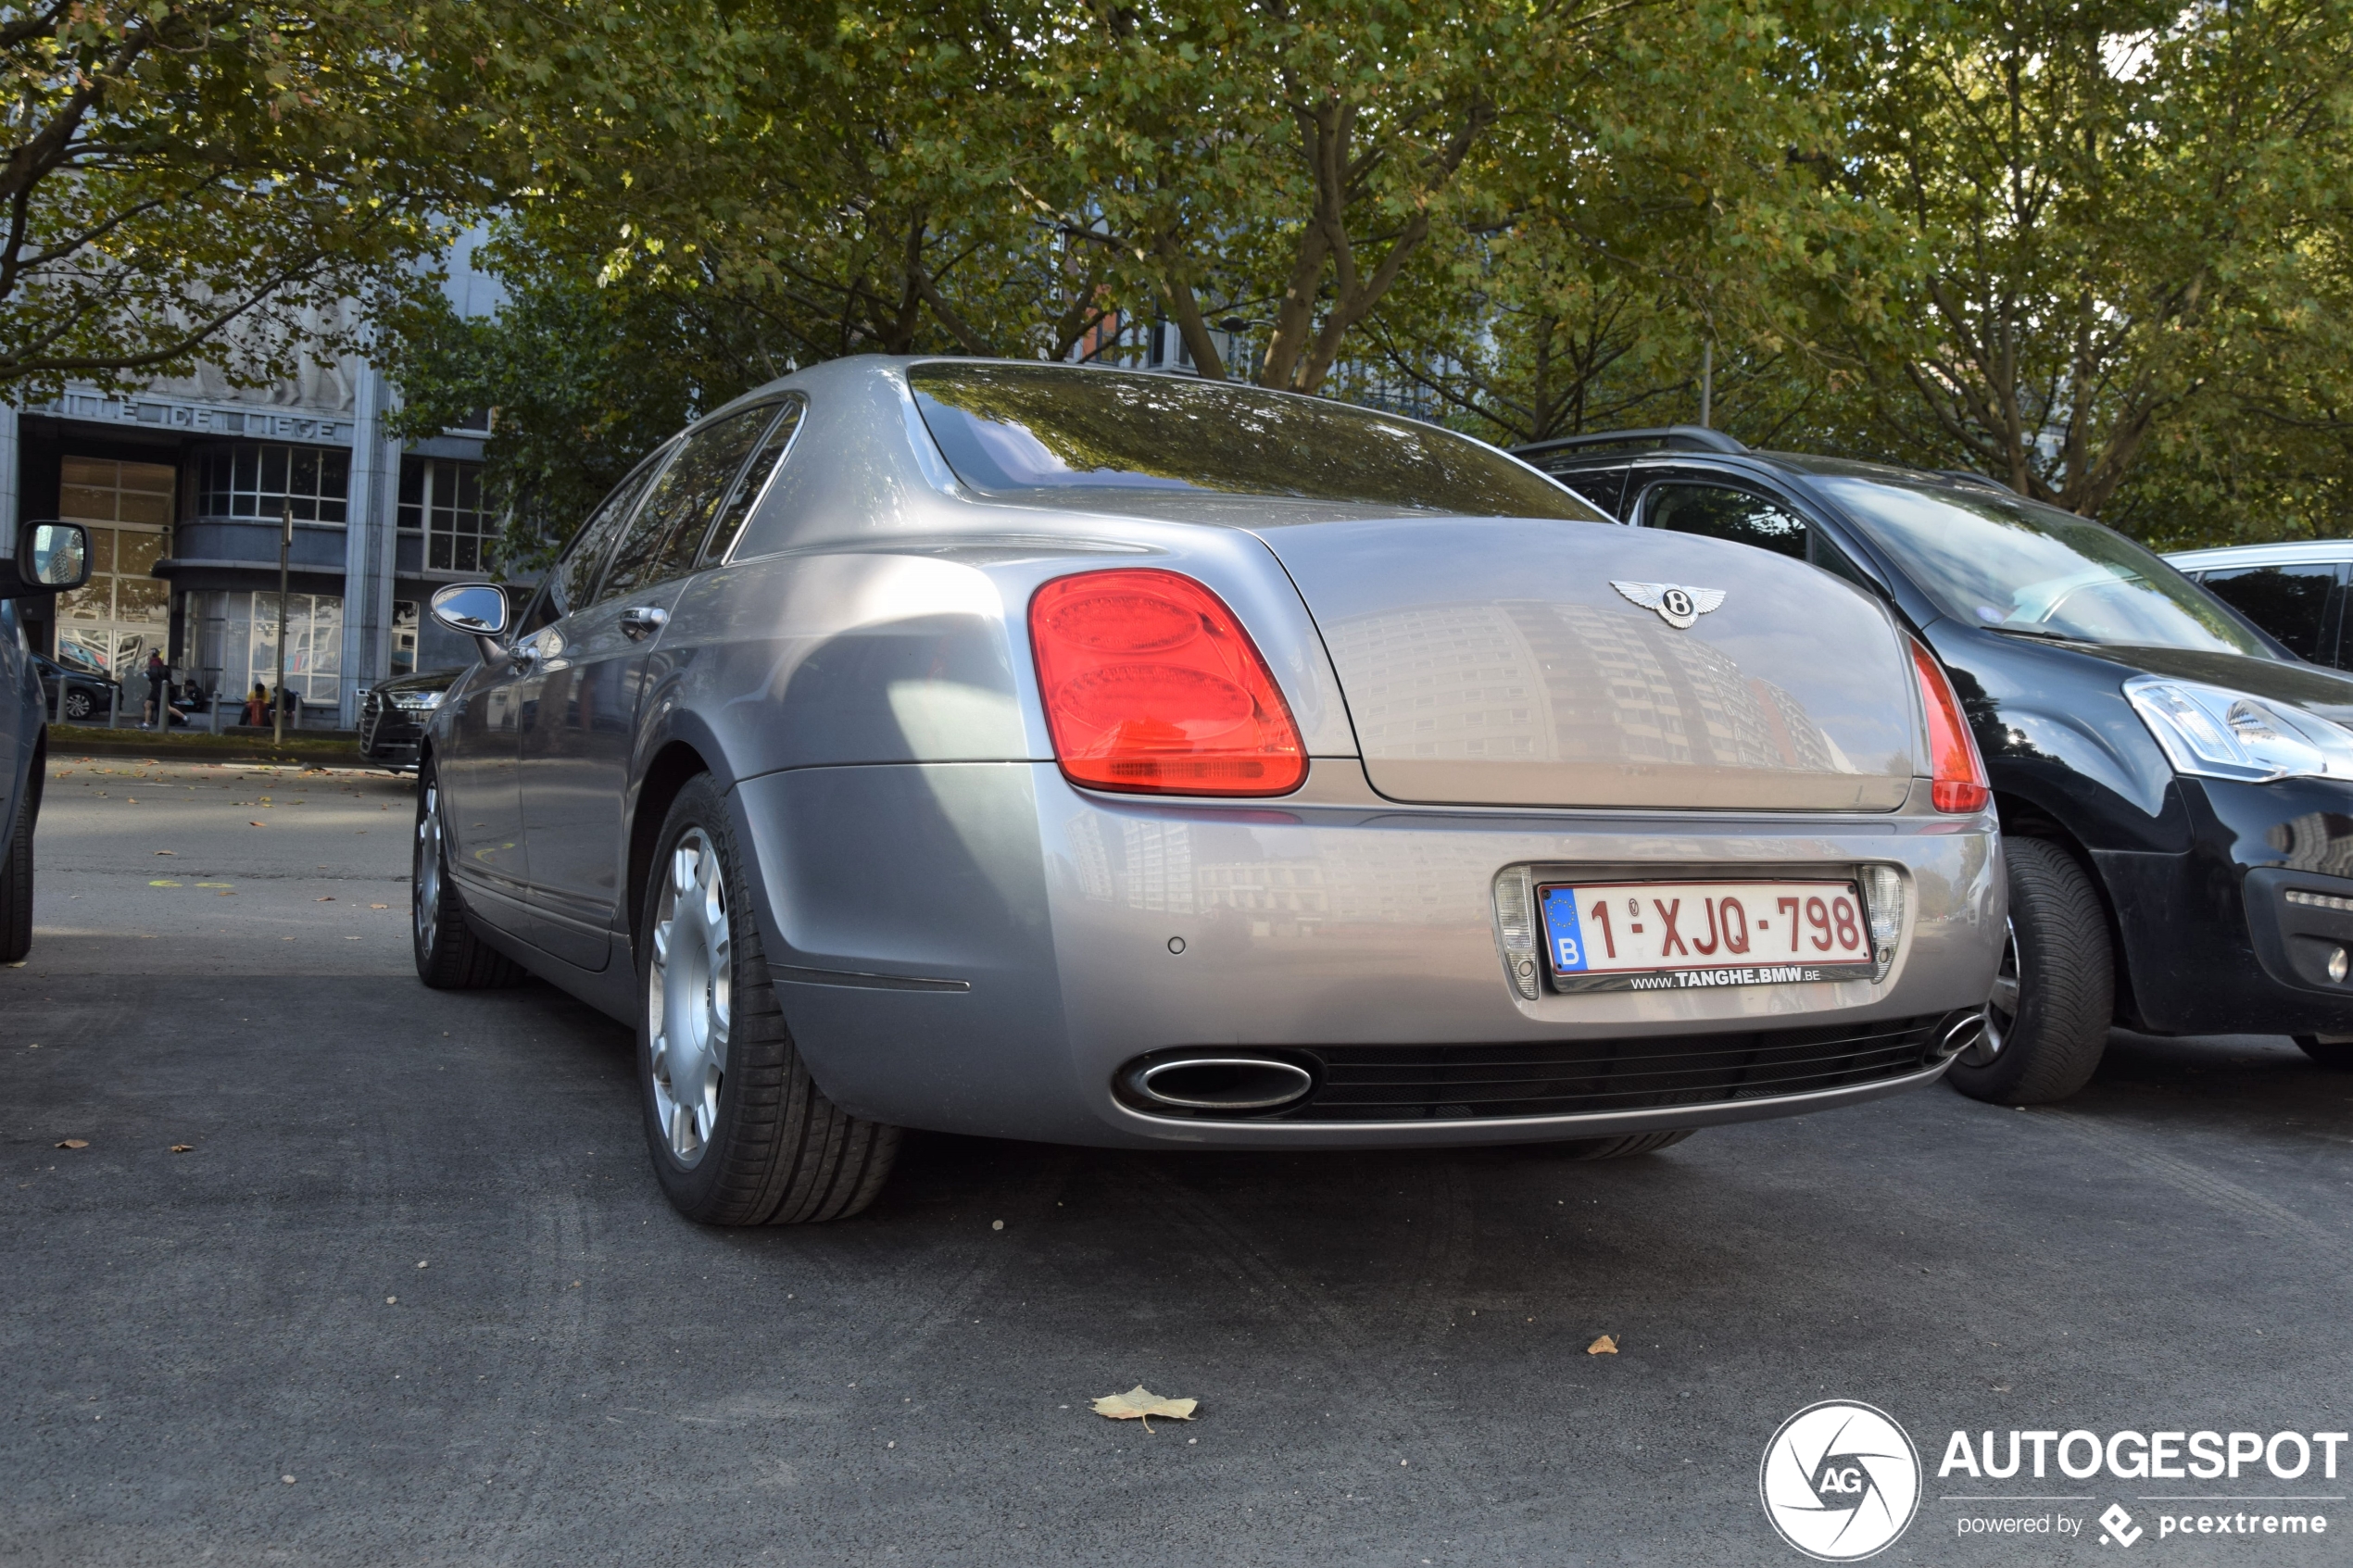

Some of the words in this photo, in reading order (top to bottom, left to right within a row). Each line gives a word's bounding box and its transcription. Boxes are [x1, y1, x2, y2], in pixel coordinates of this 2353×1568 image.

[170, 408, 212, 427] DE
[244, 414, 335, 440] LIEGE
[1591, 896, 1860, 959] 1-XJQ-798
[1558, 938, 1579, 965] B
[1630, 967, 1821, 990] WWW.TANGHE.BMW.BE
